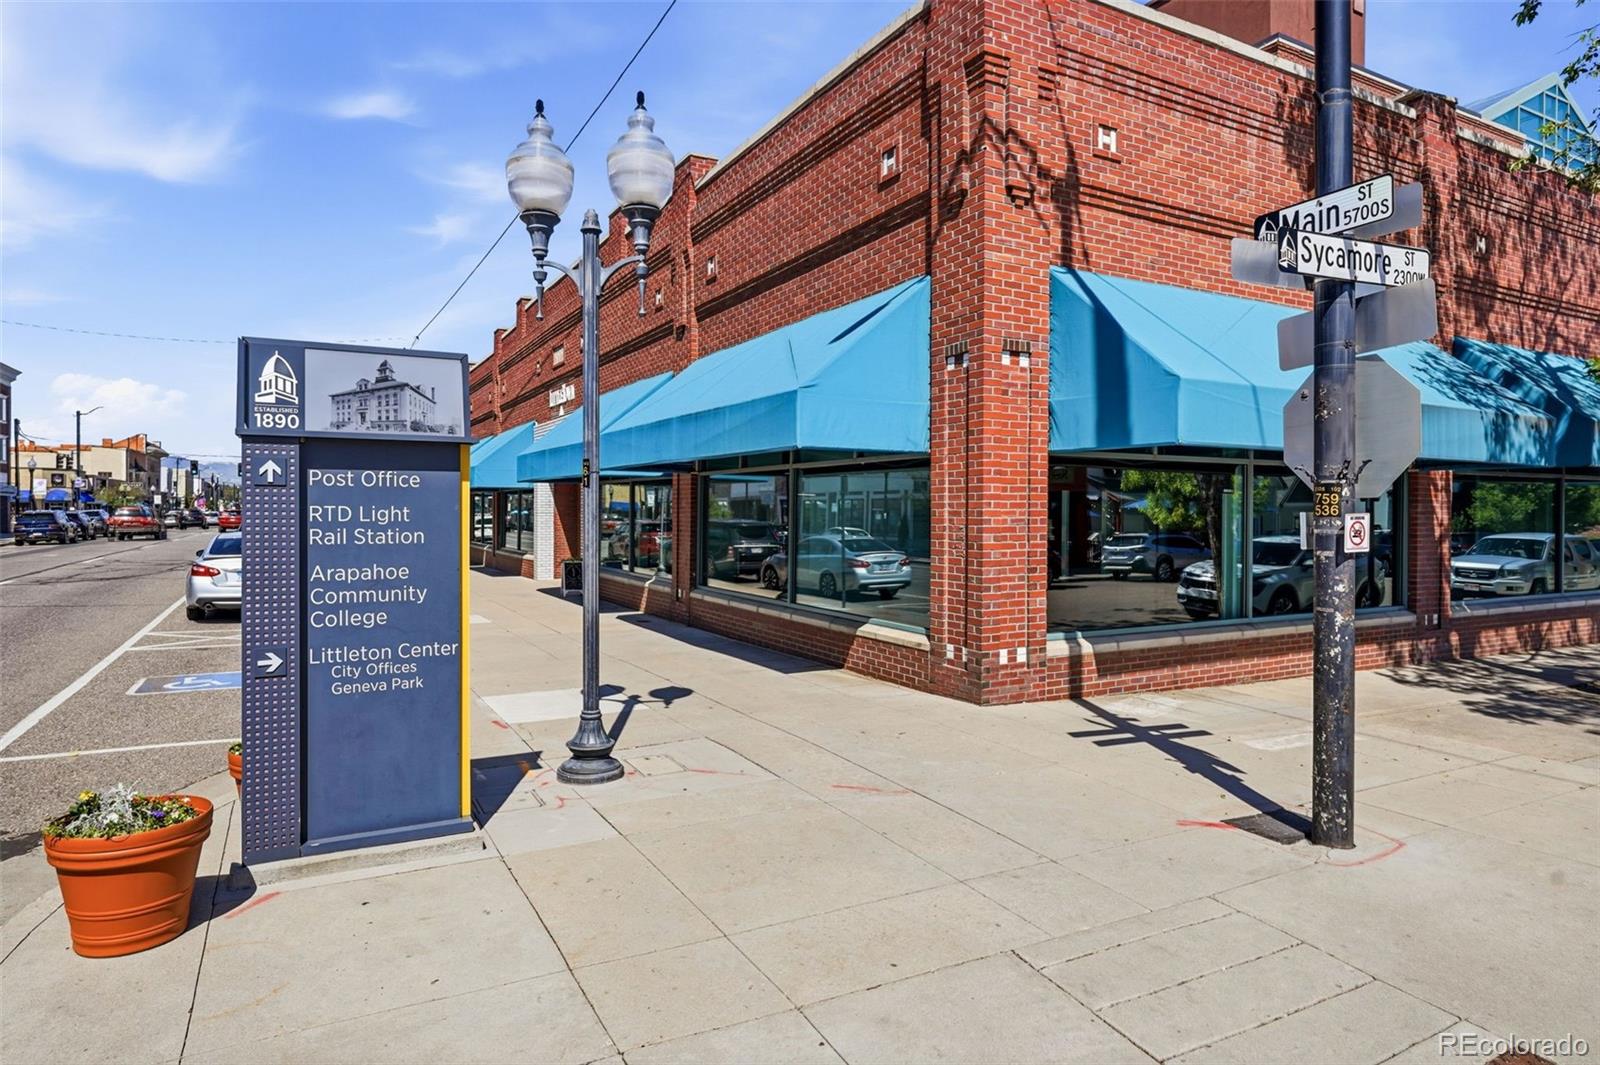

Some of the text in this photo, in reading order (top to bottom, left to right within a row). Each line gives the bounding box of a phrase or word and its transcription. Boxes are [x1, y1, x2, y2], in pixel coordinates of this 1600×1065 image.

[1282, 183, 1374, 233] Main ST
[1344, 199, 1389, 226] 5700S
[1301, 235, 1415, 275] Sycamore ST
[254, 406, 299, 414] ESTABLISHED
[254, 413, 299, 429] 1890
[309, 469, 421, 488] Post Office
[1315, 493, 1339, 504] 759
[309, 505, 410, 525] RTD Light
[1315, 505, 1339, 516] 536
[309, 528, 425, 545] Rail Station
[310, 564, 409, 583] Arapahoe
[310, 585, 427, 605] Community
[310, 610, 388, 628] College
[309, 642, 459, 664] Littleton Center
[331, 661, 417, 679] City Offices
[331, 676, 424, 695] Geneva Park
